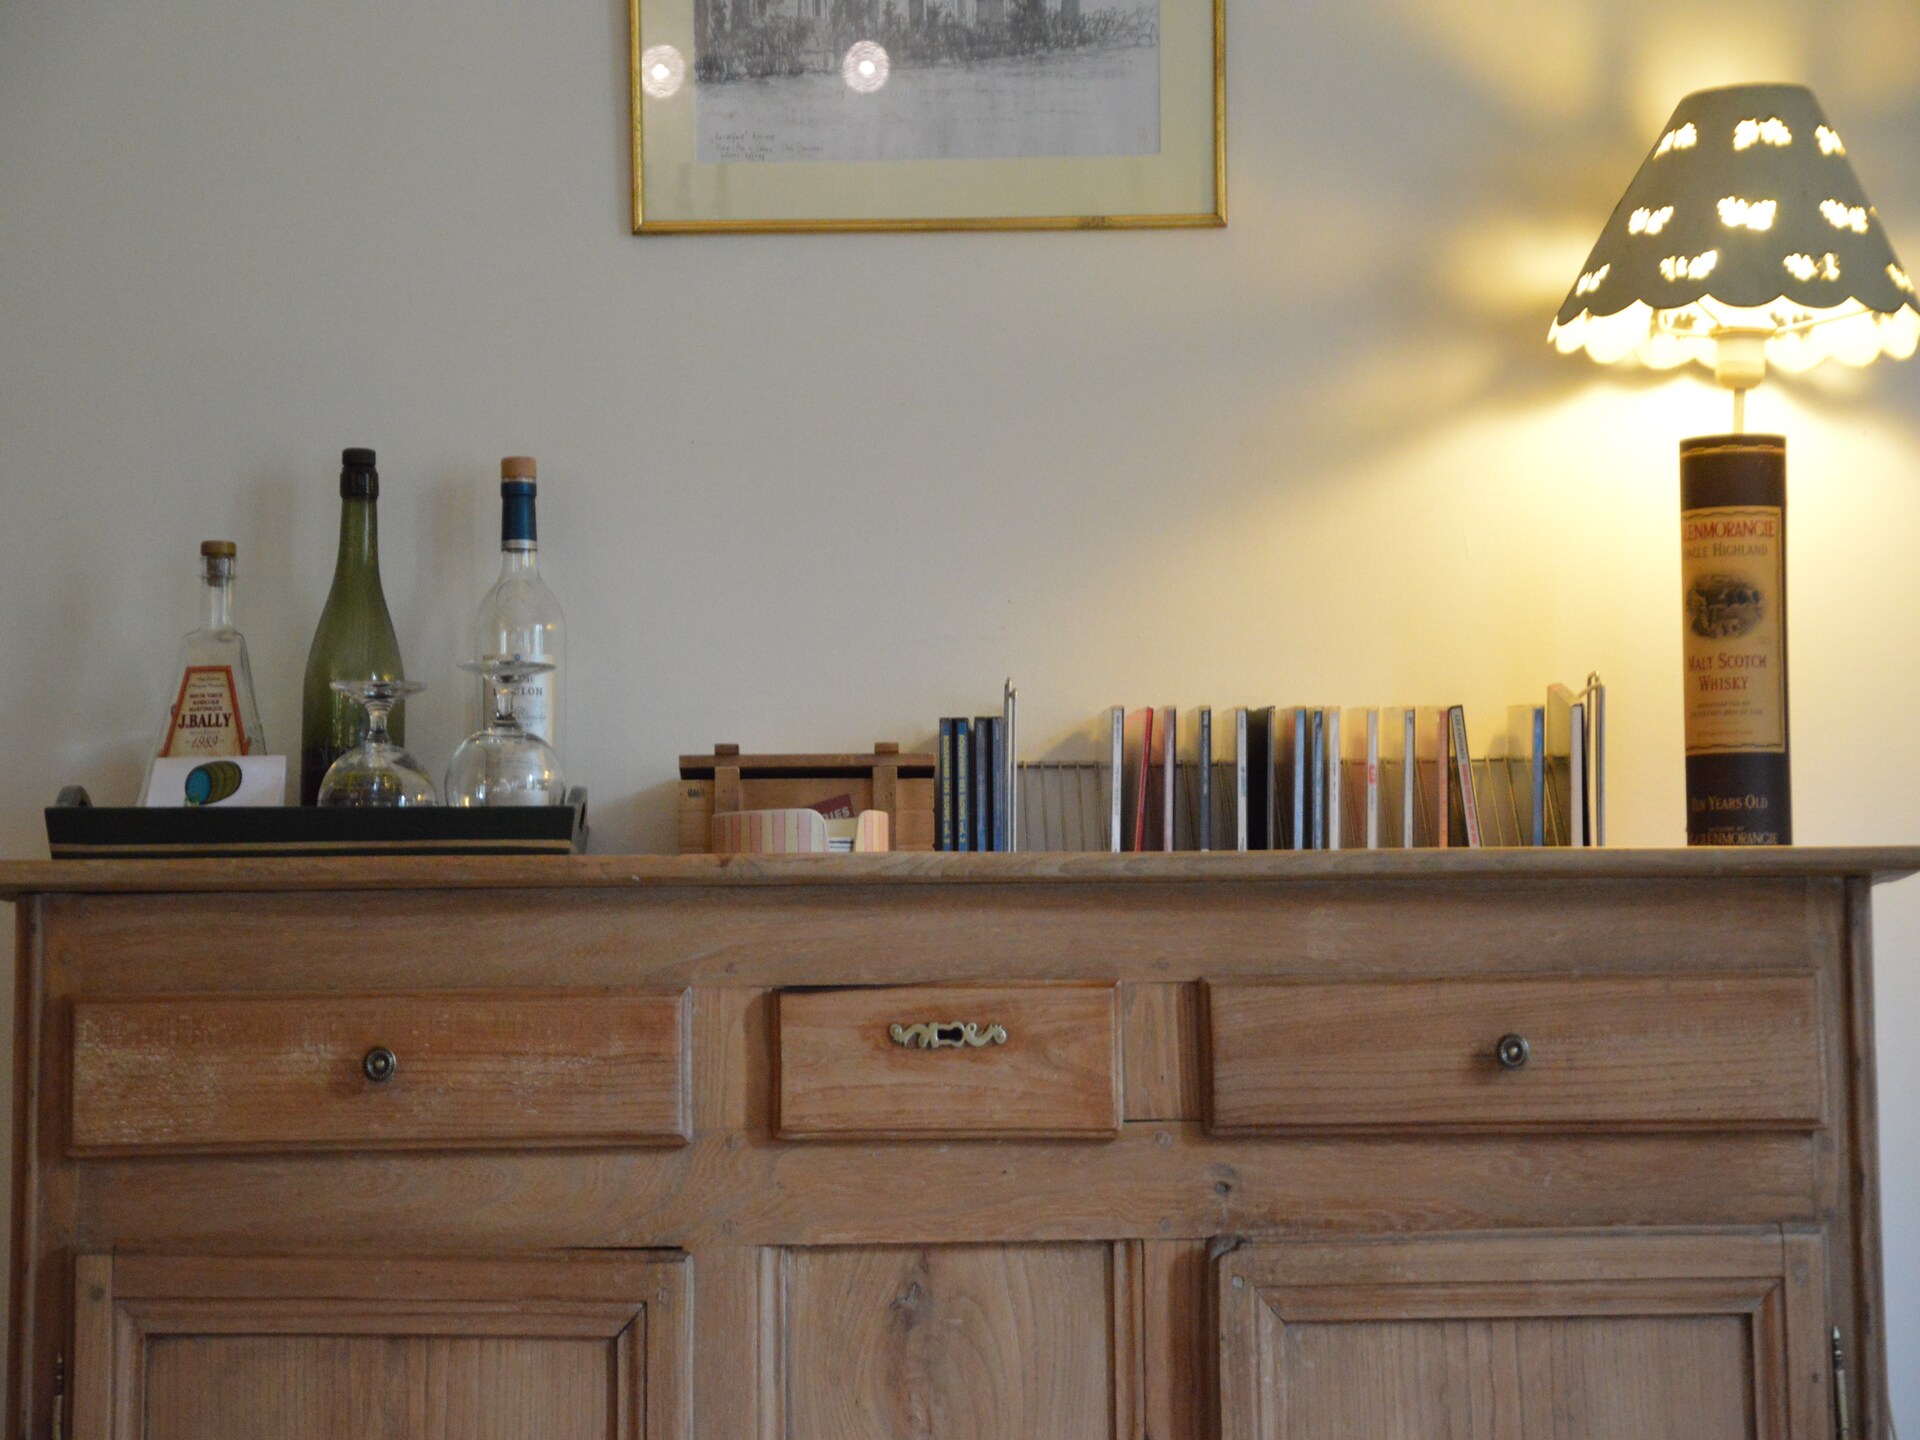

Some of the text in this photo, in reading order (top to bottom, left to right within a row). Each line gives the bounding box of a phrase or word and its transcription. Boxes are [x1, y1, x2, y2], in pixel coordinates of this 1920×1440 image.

[1717, 652, 1767, 669] SCOTCH
[1699, 675, 1749, 691] WHISKY
[178, 713, 232, 728] J.BALLY
[1708, 795, 1743, 811] YEARS
[1745, 793, 1768, 810] OLD
